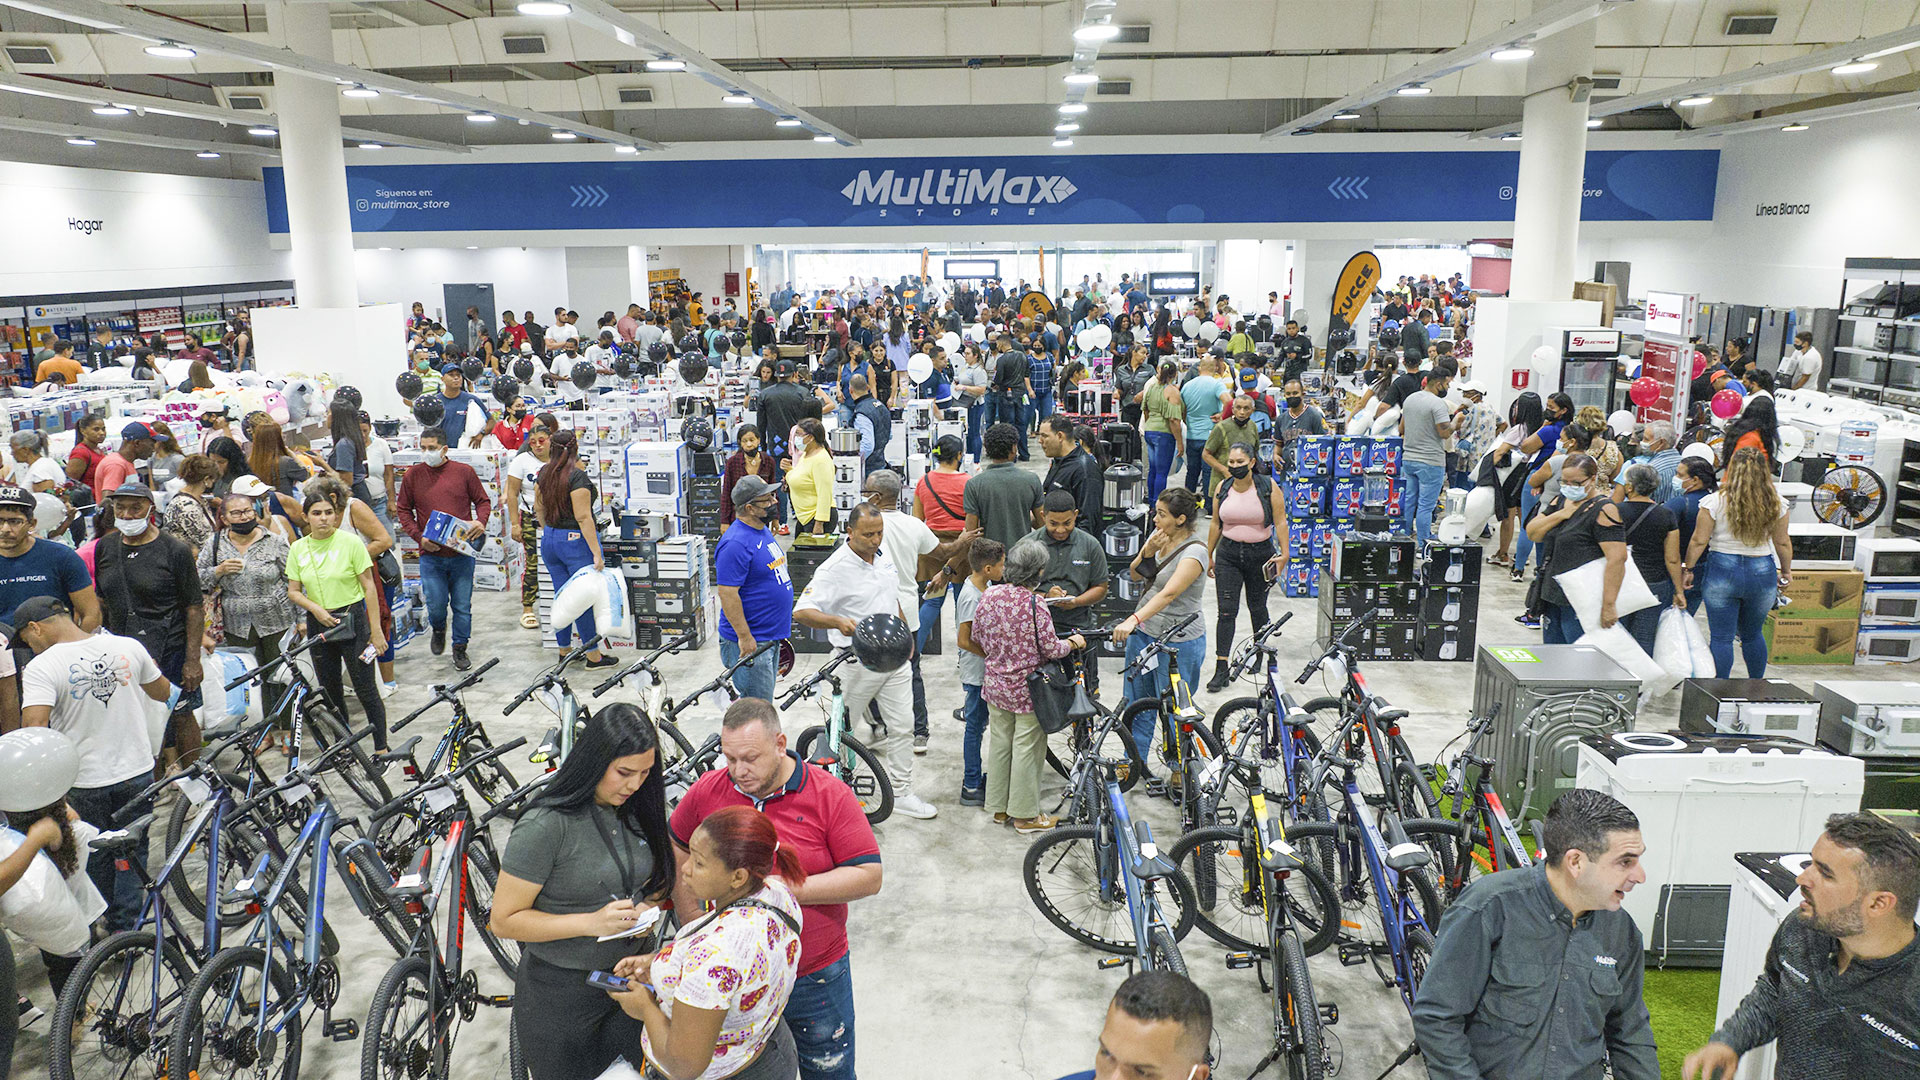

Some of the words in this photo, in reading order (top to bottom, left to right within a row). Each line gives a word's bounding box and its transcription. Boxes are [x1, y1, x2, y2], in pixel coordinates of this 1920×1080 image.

[375, 188, 417, 199] Síguenos
[418, 189, 433, 197] en:
[852, 168, 1062, 206] MultiMax
[371, 200, 450, 210] multimax_store
[1755, 203, 1778, 217] Línea
[1779, 202, 1810, 216] Blanca
[67, 217, 104, 236] Hogar
[1571, 336, 1585, 347] SJ
[16, 575, 47, 583] HILFIGER
[1863, 1013, 1916, 1050] MultiMax
